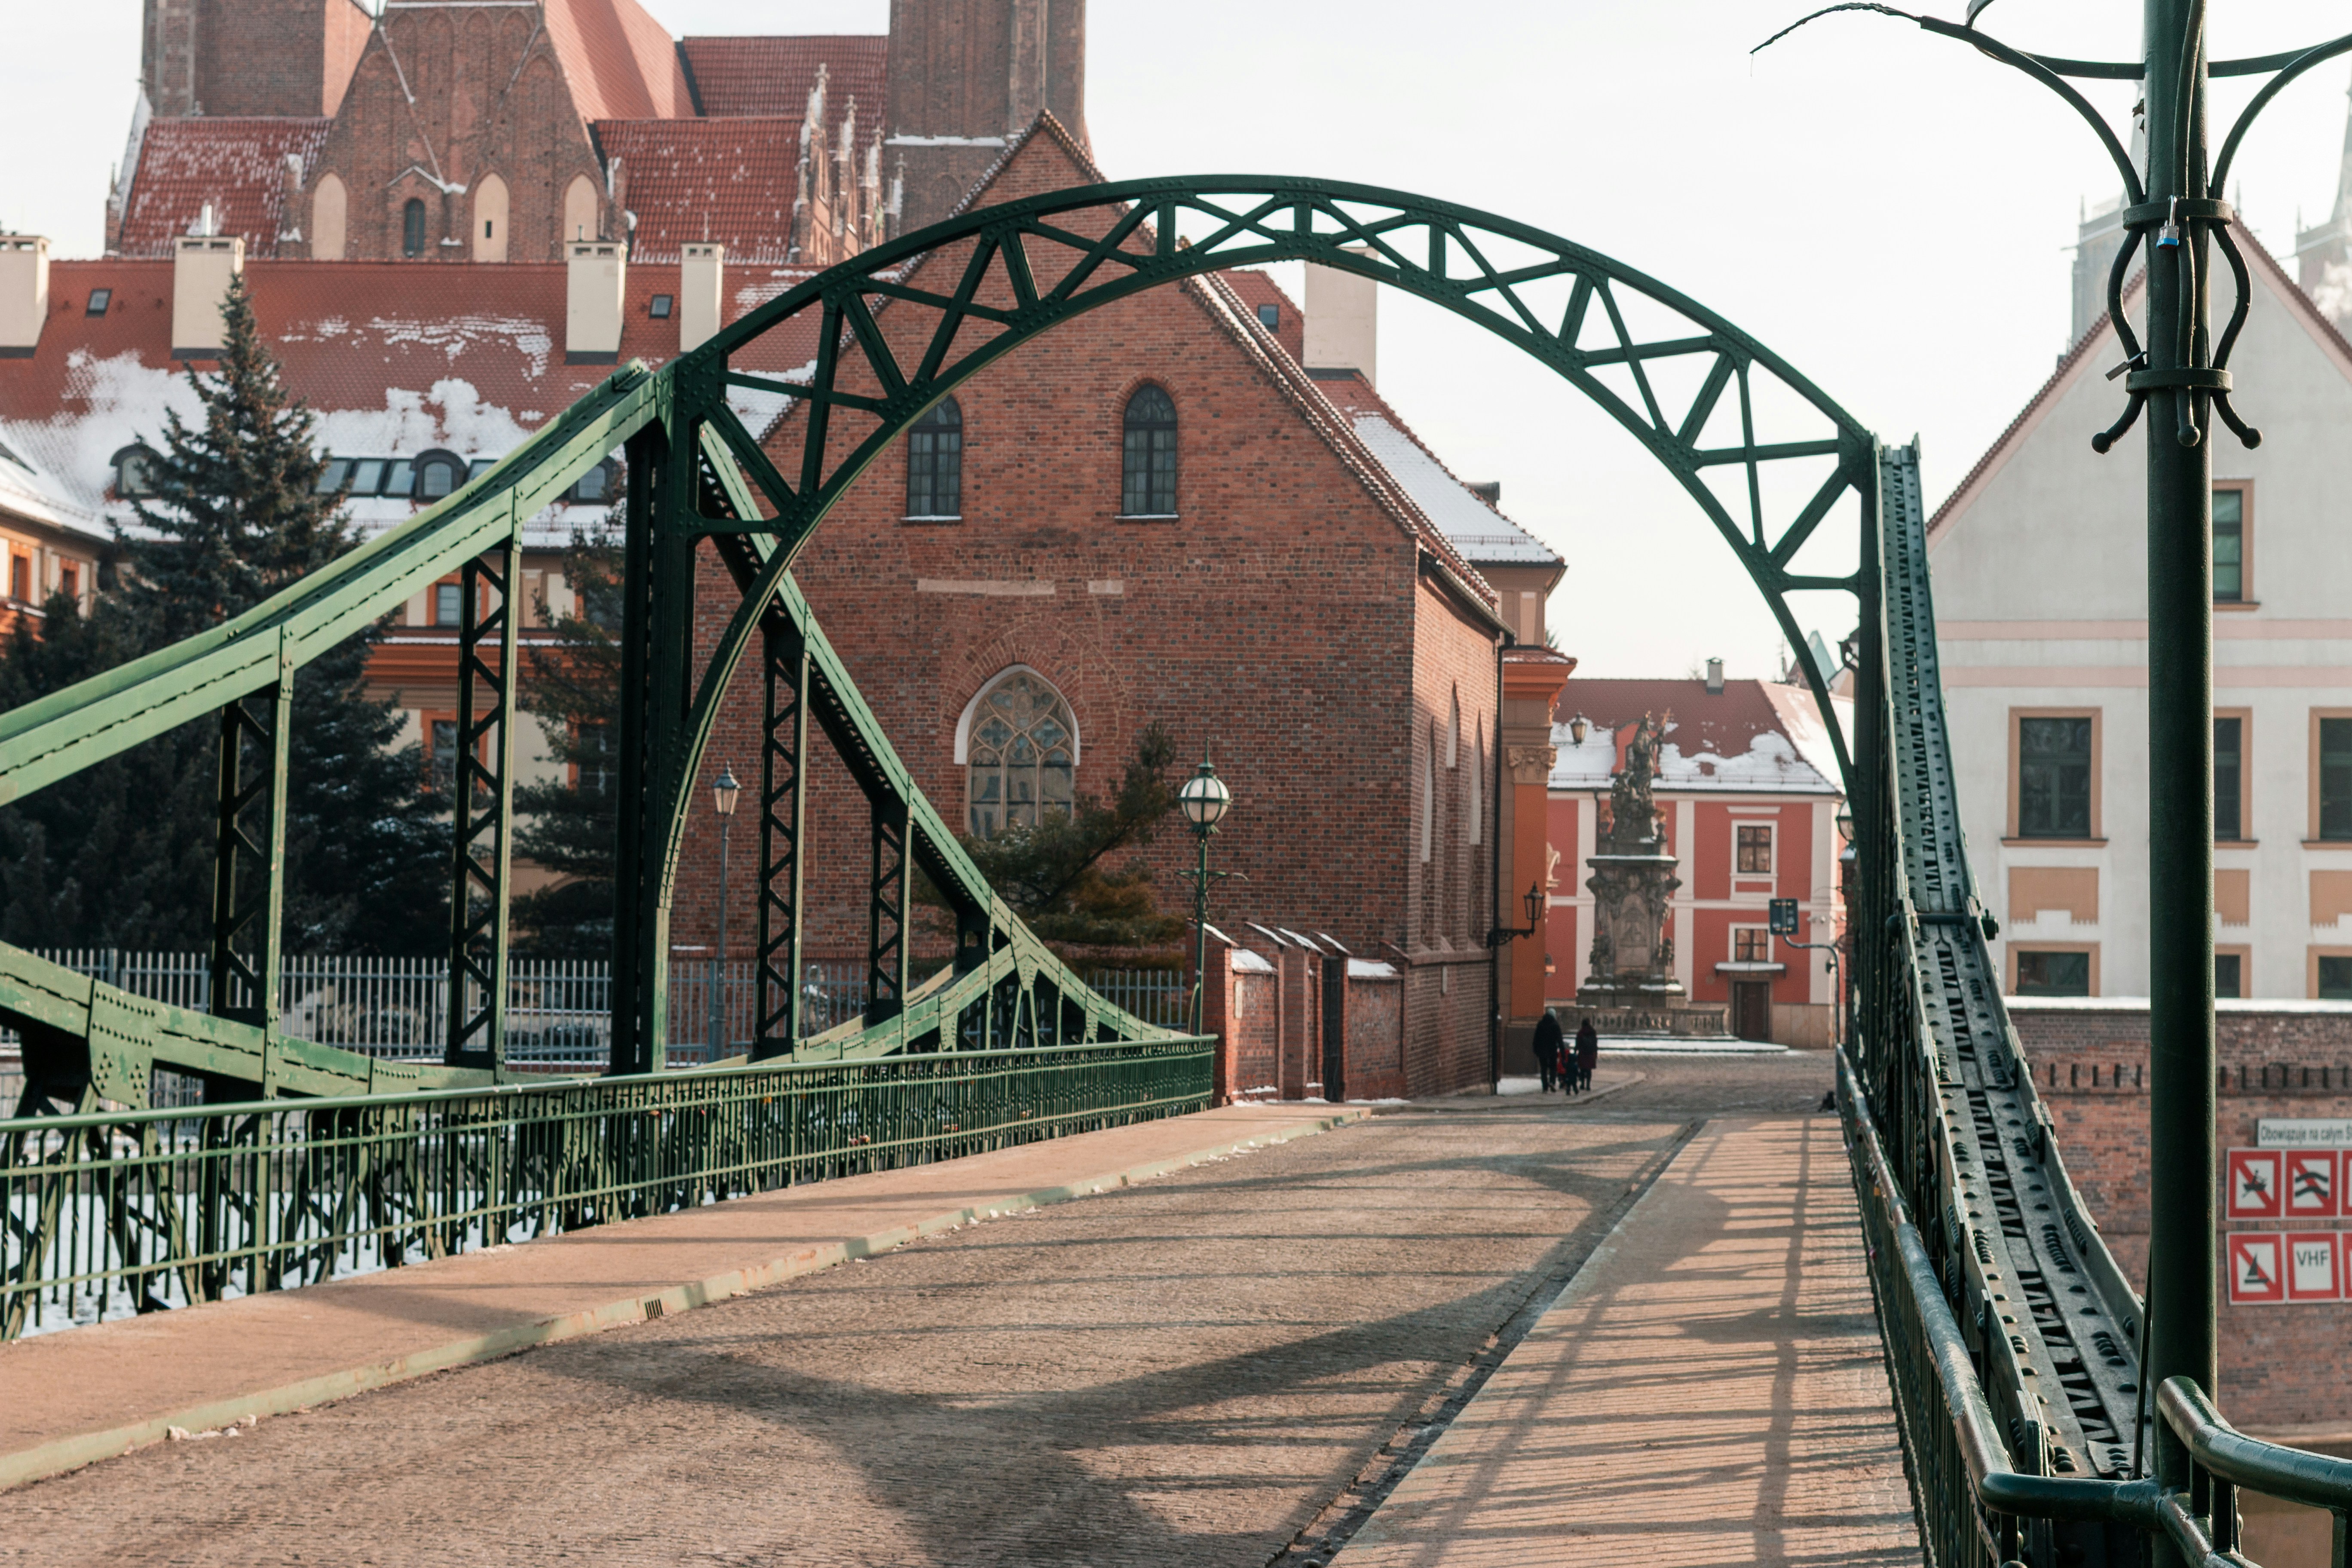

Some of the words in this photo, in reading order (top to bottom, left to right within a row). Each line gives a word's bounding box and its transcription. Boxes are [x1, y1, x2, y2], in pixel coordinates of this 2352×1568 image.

[2261, 1125, 2306, 1144] Obowiązuje
[2309, 1128, 2318, 1140] na
[2321, 1125, 2343, 1145] całym
[2296, 1249, 2329, 1266] VHF
